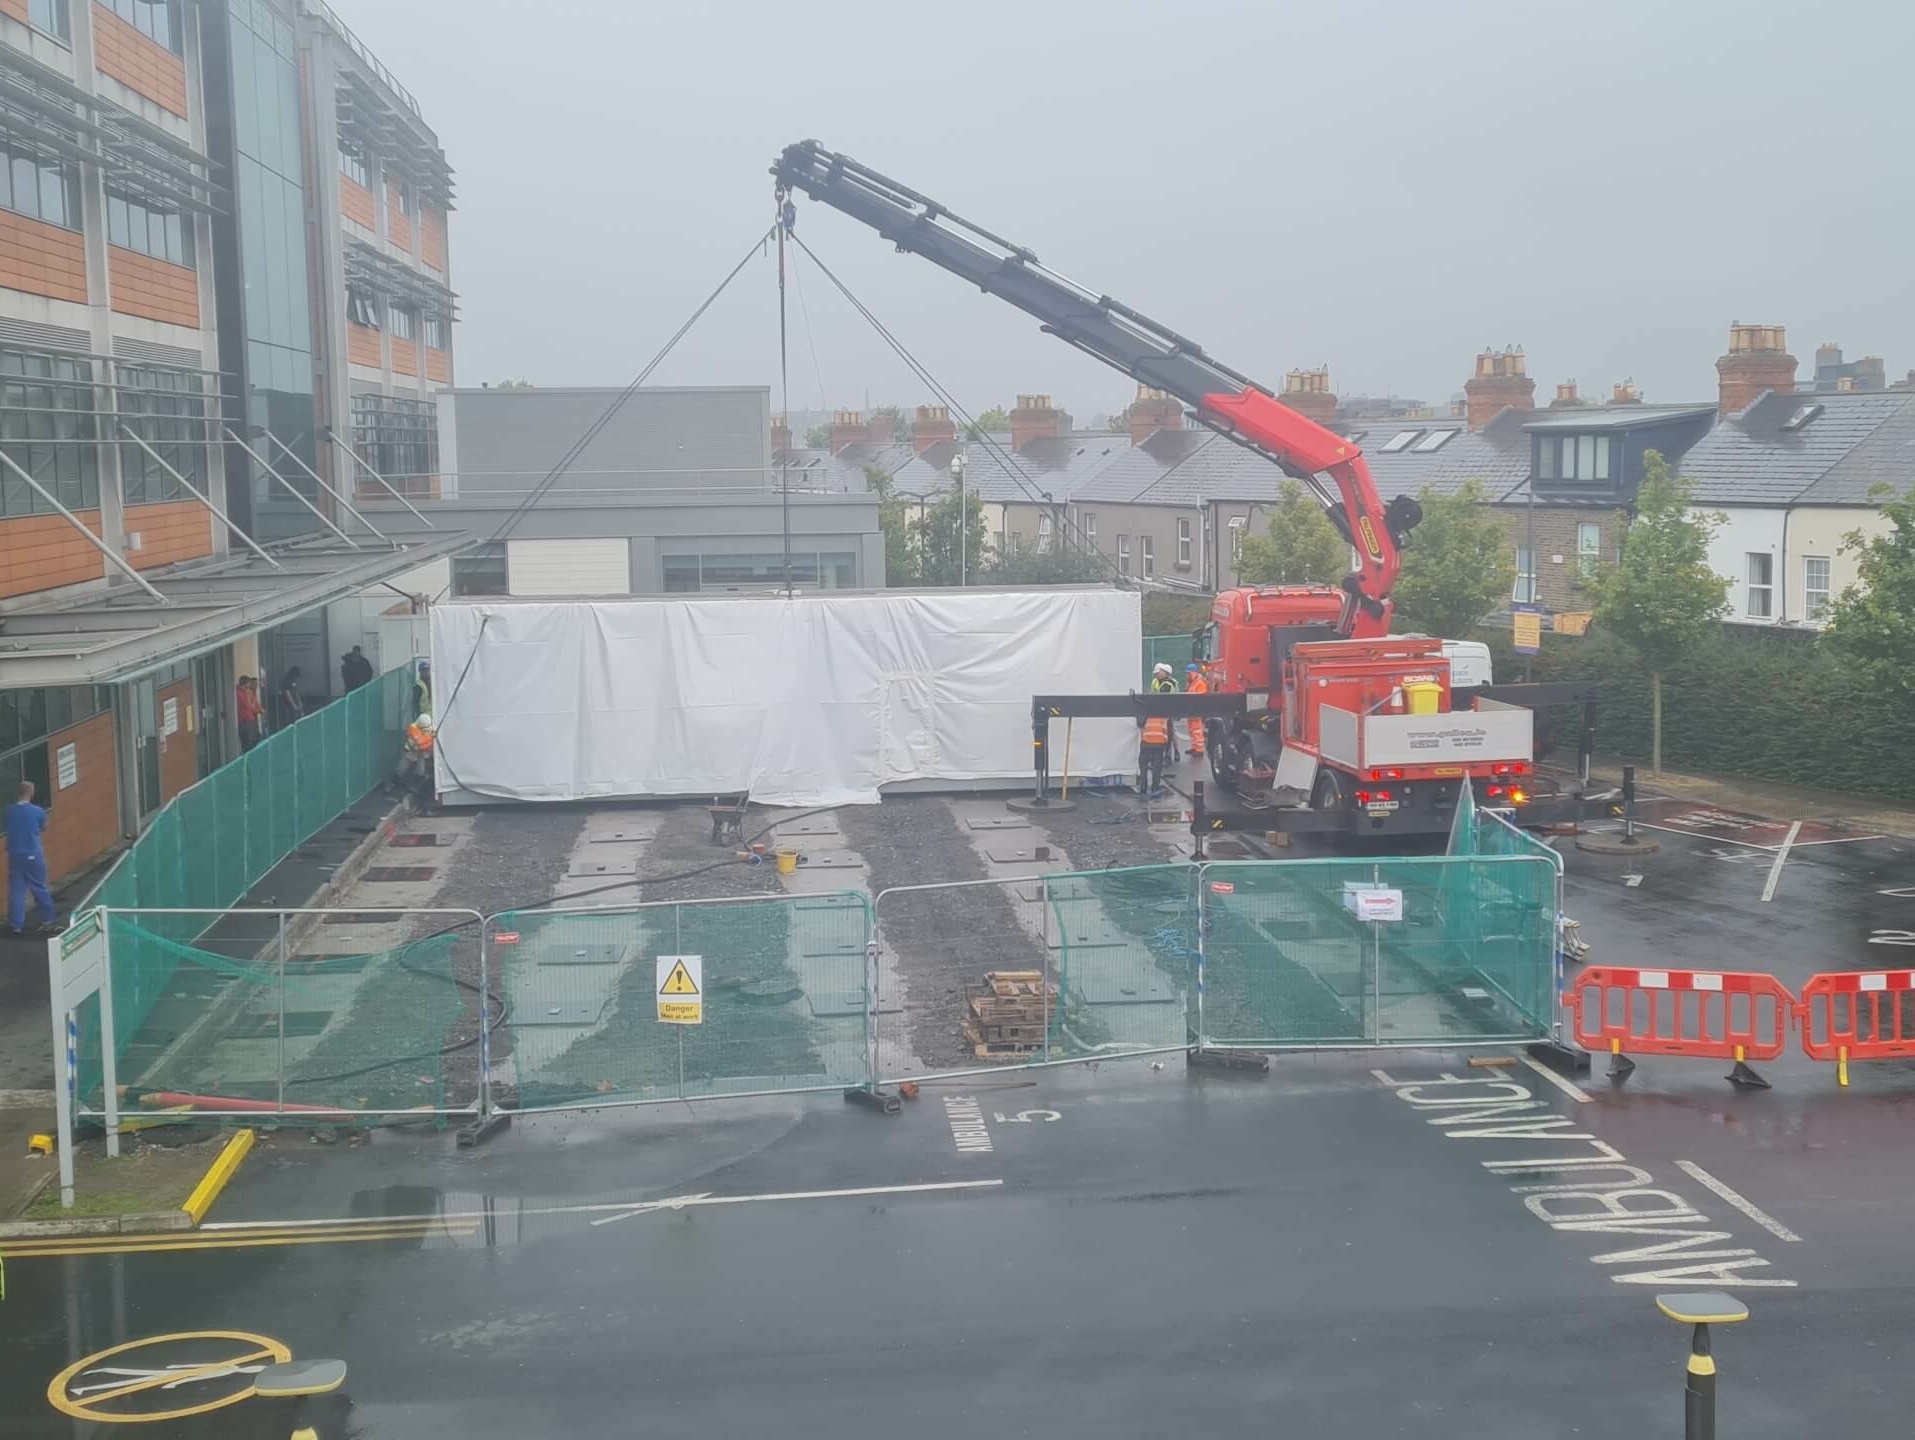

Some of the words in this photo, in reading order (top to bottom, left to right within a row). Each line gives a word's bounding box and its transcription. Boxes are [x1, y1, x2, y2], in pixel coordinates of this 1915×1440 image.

[665, 1004, 694, 1013] Danger
[943, 1096, 994, 1152] AMBULANCE
[993, 1109, 1062, 1123] 5
[1370, 1066, 1799, 1287] AMBULANCE
